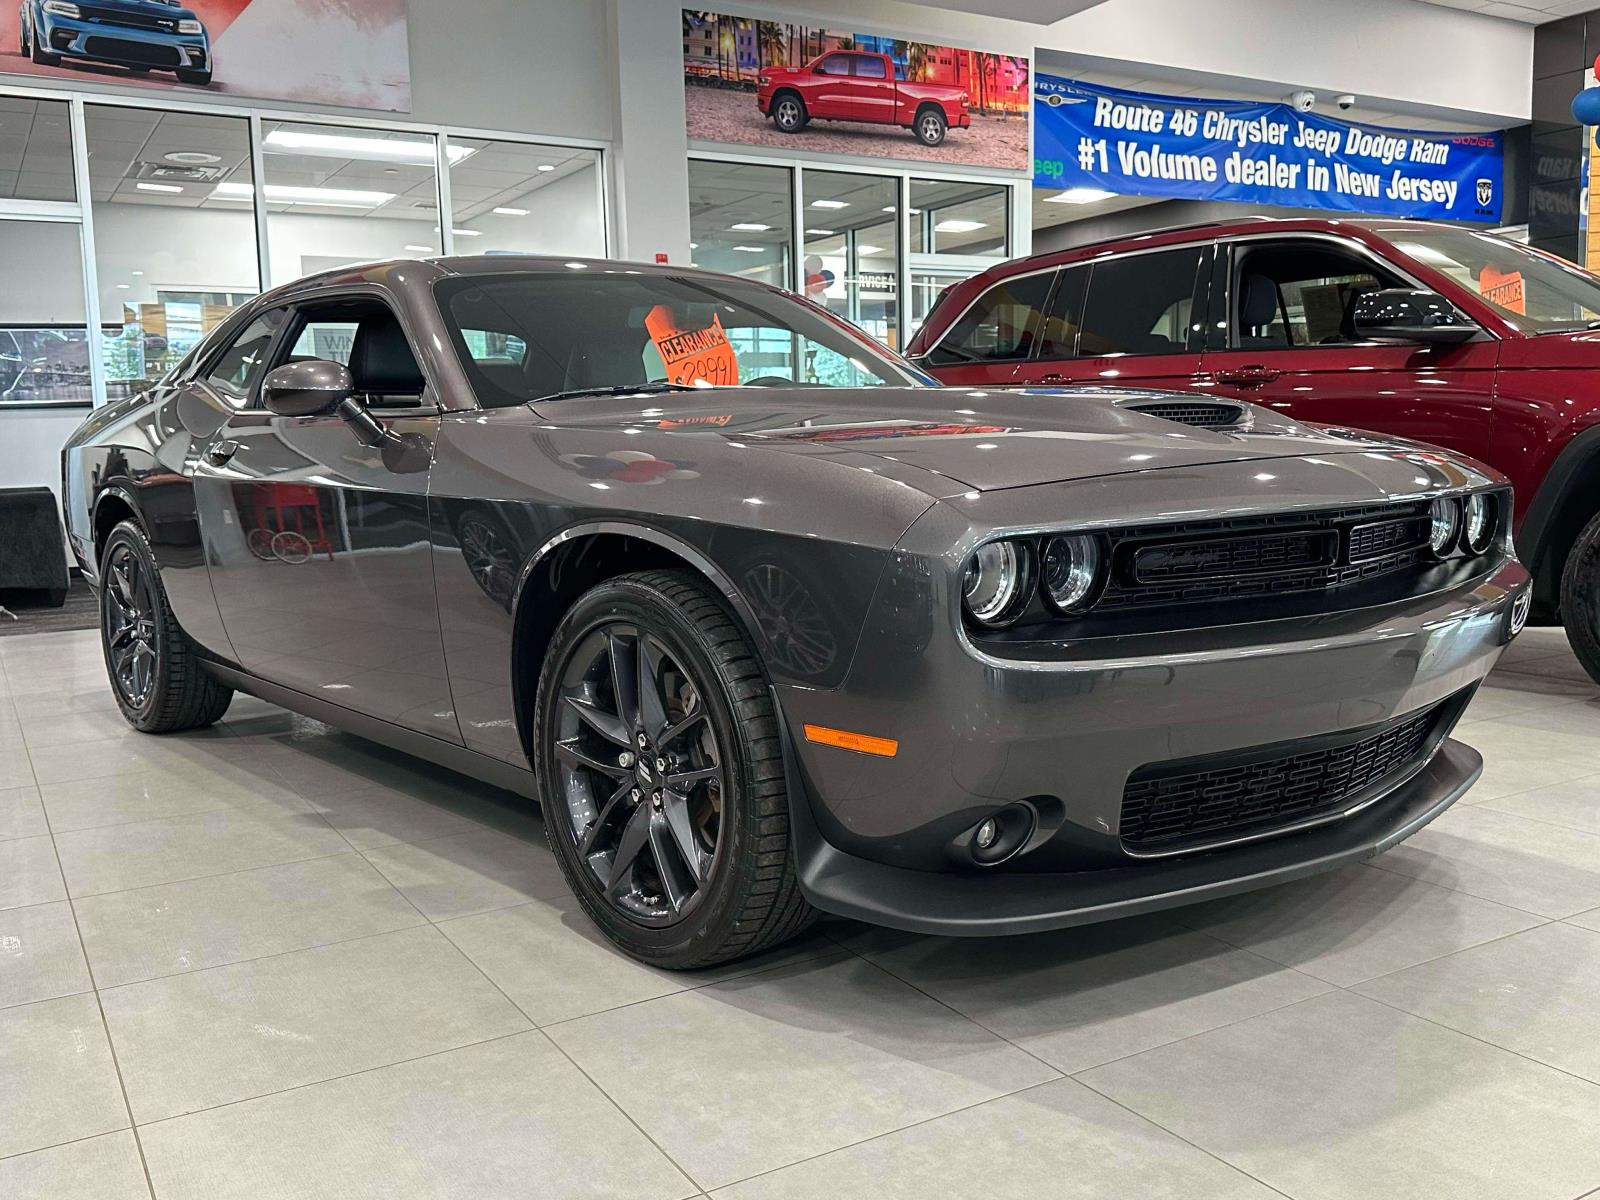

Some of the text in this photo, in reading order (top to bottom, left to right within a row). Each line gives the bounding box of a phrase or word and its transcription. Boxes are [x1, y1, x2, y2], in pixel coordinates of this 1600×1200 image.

[1094, 97, 1450, 165] Route 46 Chrysler Jeep Dodge Ram
[1452, 136, 1495, 148] DODGE
[1034, 159, 1063, 179] eep
[1077, 137, 1457, 210] #1 Volume dealer in New Jersey
[857, 274, 888, 288] RVICE
[660, 324, 725, 364] CLEARANCE
